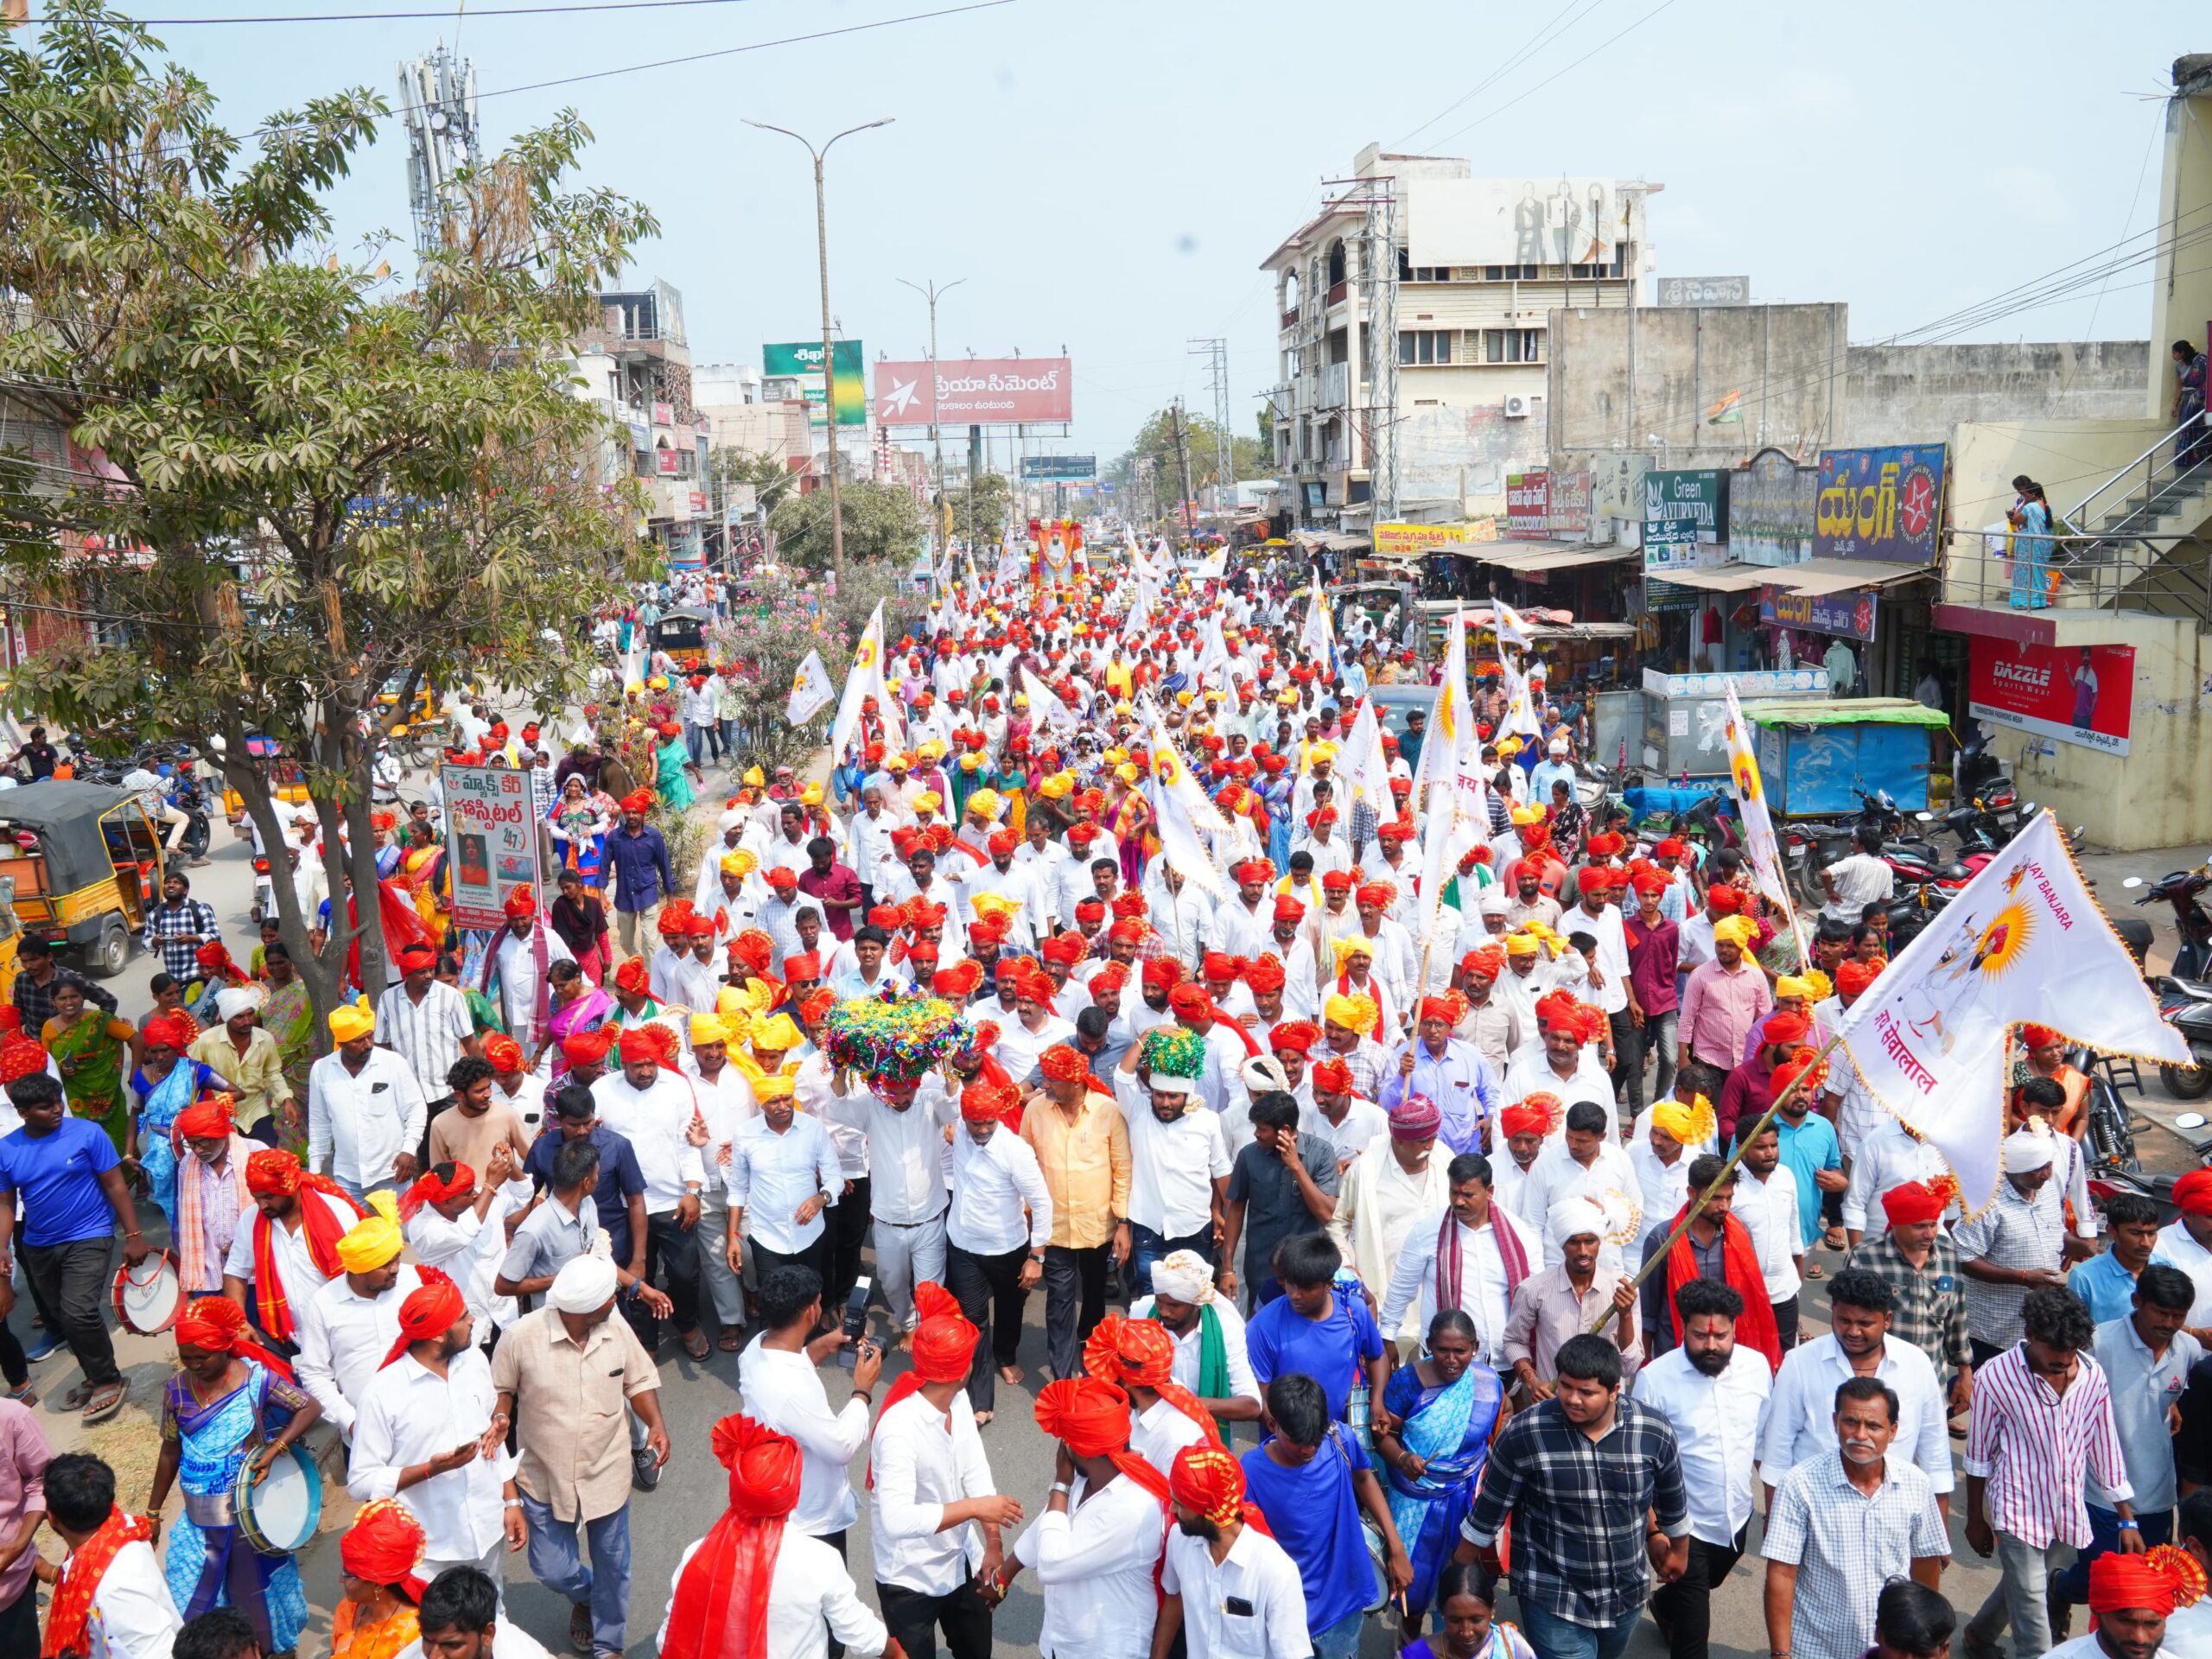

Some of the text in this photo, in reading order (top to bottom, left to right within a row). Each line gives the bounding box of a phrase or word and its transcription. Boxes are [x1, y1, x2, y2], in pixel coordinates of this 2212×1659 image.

[988, 371, 1059, 391] సిమెంట్
[1674, 475, 1701, 499] Green
[1903, 465, 1936, 492] YOUNG STARS
[1662, 500, 1715, 527] AYURVEDA
[1777, 594, 1811, 625] యంగ
[1993, 660, 2051, 687] DAZZLE
[1993, 677, 2024, 691] Sports
[2027, 684, 2050, 696] Wear
[463, 773, 522, 798] మ్యాక్స్ కేర్
[1458, 773, 1479, 793] जय
[2029, 862, 2073, 931] JAY BANJARA
[1881, 1020, 1938, 1095] सेवालाल
